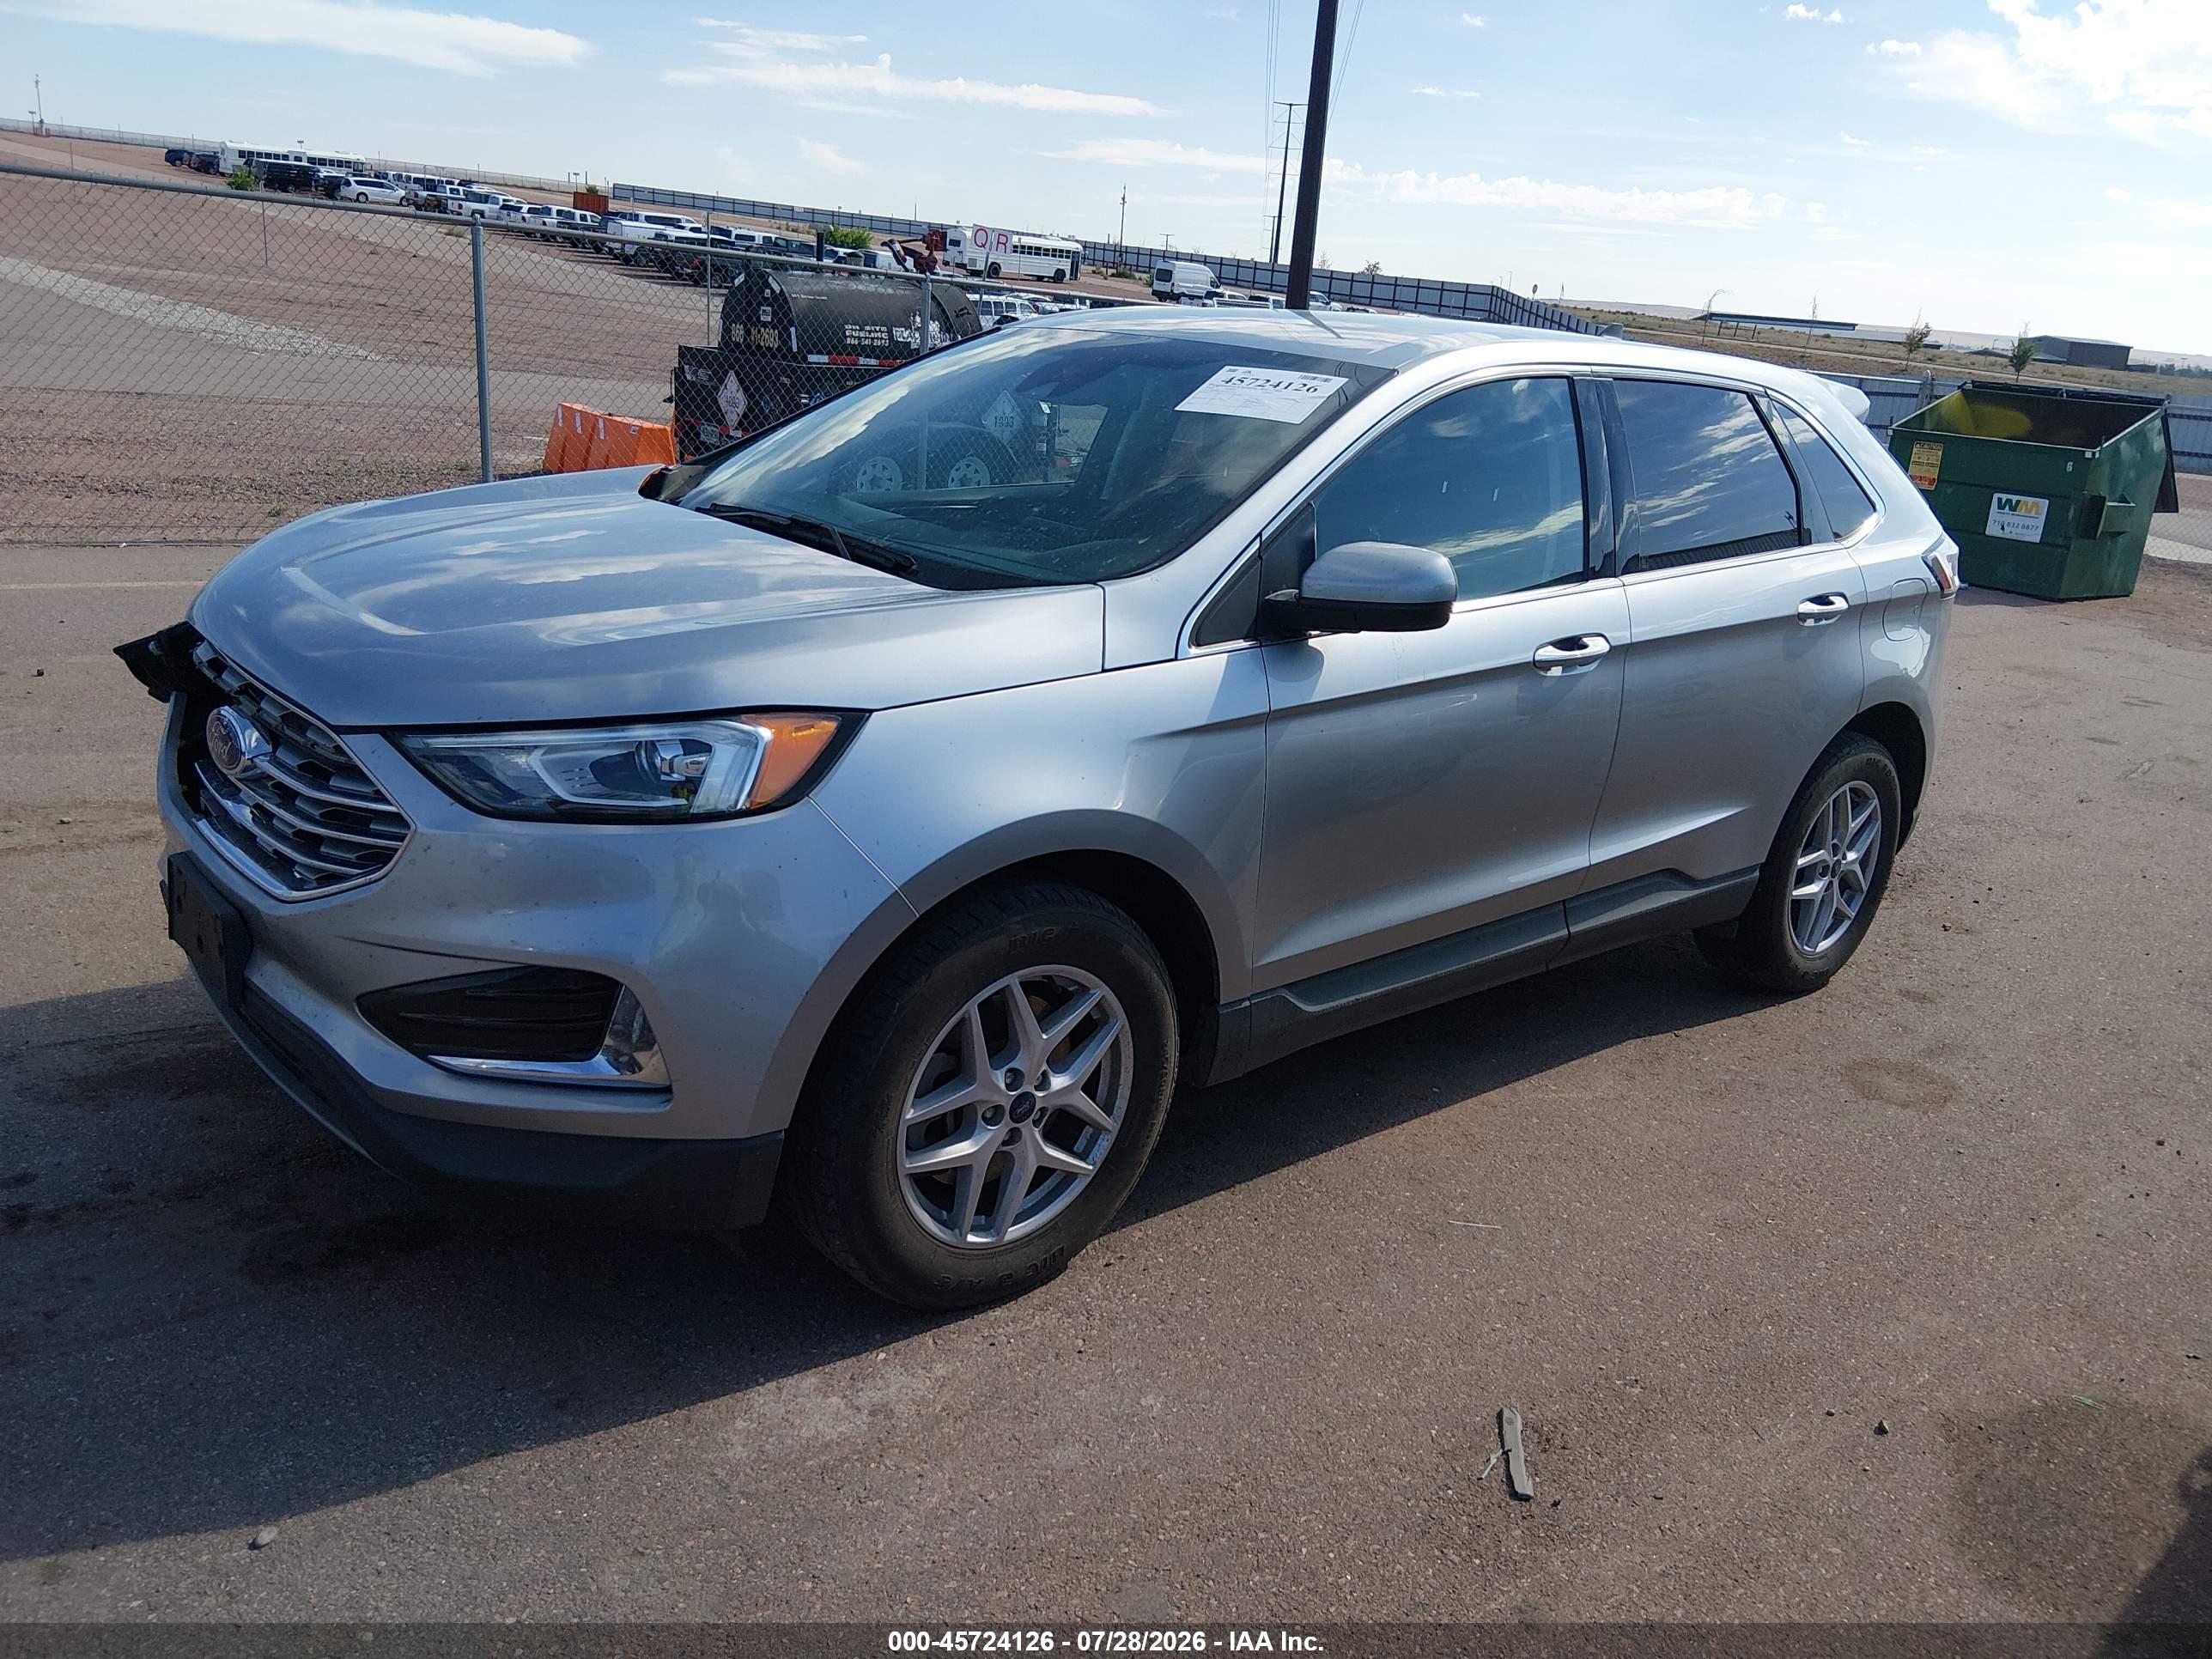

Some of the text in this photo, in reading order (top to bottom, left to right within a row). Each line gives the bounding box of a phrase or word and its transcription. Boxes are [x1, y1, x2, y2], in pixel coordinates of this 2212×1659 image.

[974, 228, 988, 249] Q
[995, 233, 1008, 254] R
[1220, 376, 1320, 393] 45724126
[2066, 461, 2074, 472] 6
[1996, 496, 2042, 515] WM
